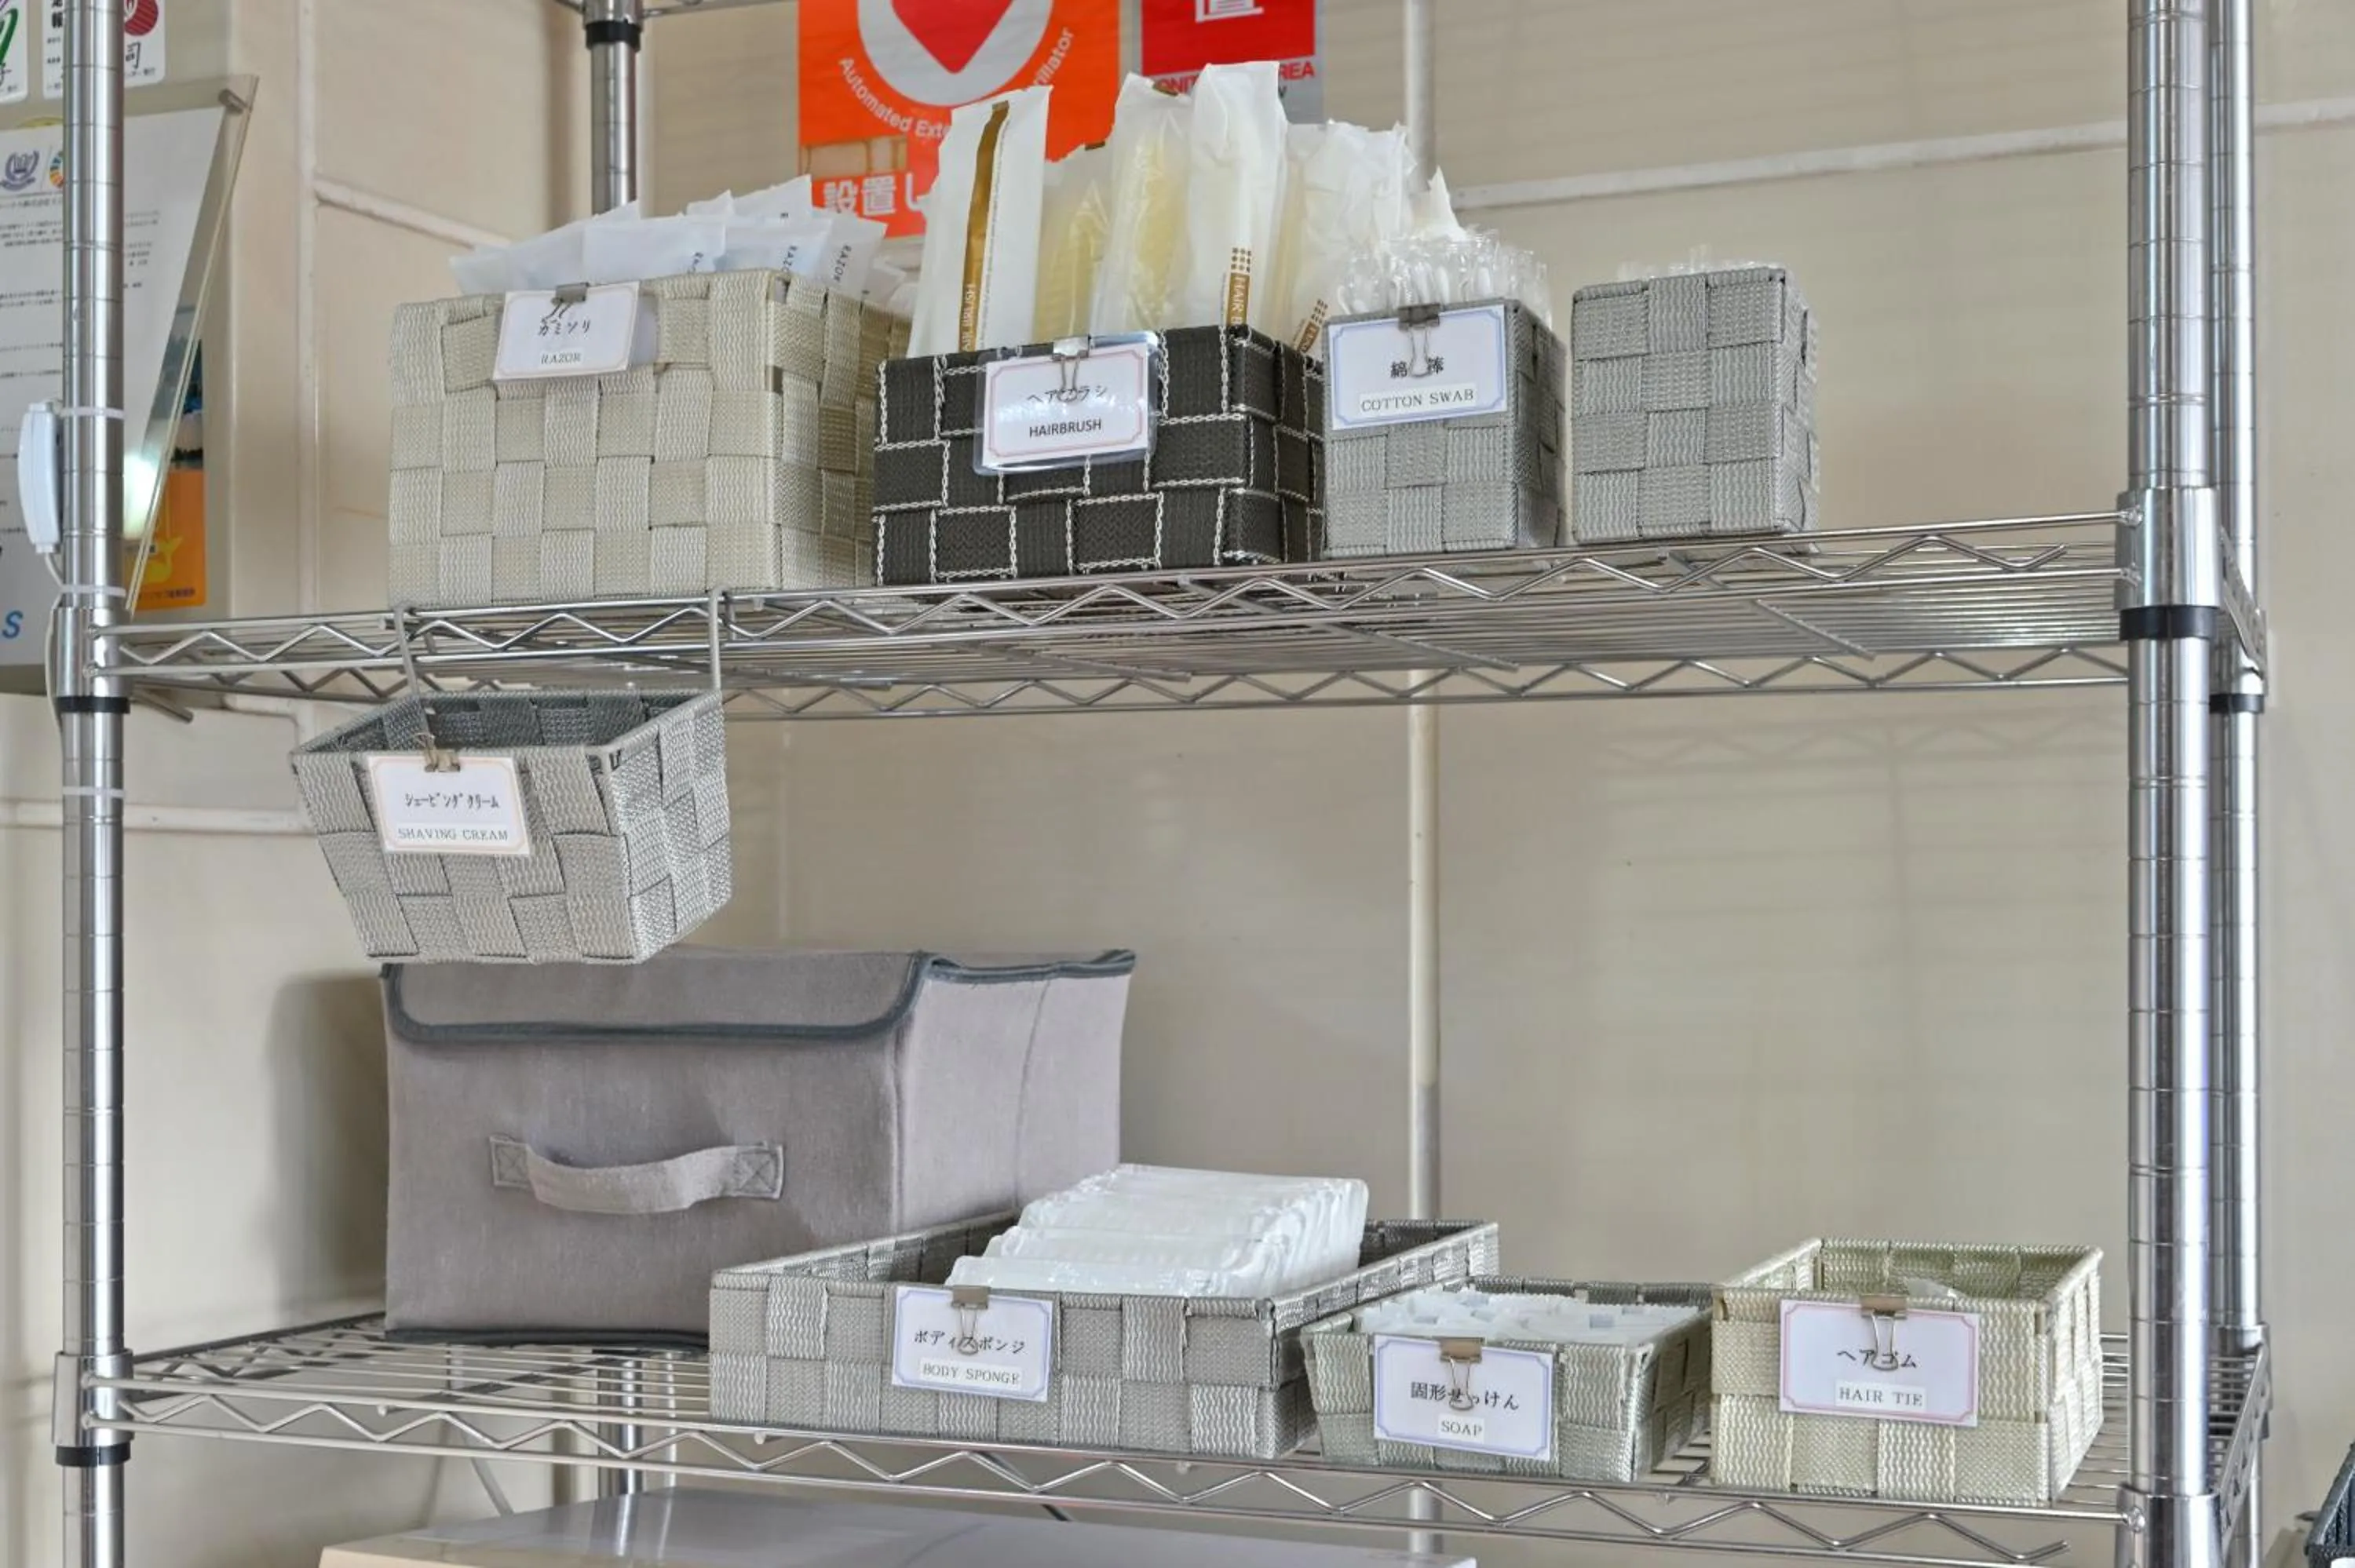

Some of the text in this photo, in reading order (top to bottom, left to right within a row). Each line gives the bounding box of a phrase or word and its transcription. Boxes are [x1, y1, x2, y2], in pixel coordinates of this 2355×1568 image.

[838, 58, 914, 132] Automated
[823, 173, 924, 216] 設置し
[540, 353, 582, 365] RAZOR
[1360, 389, 1474, 413] COTTON SWAB
[1029, 418, 1102, 437] HAIRBRUSH
[398, 828, 509, 841] SHAVING CREAM
[1837, 1349, 1917, 1368] ヘアゴム
[923, 1362, 1020, 1385] BODY SPONGE
[1411, 1381, 1520, 1411] 固形せっけん
[1839, 1387, 1923, 1406] HAIR TIE
[1441, 1420, 1482, 1437] SOAP
